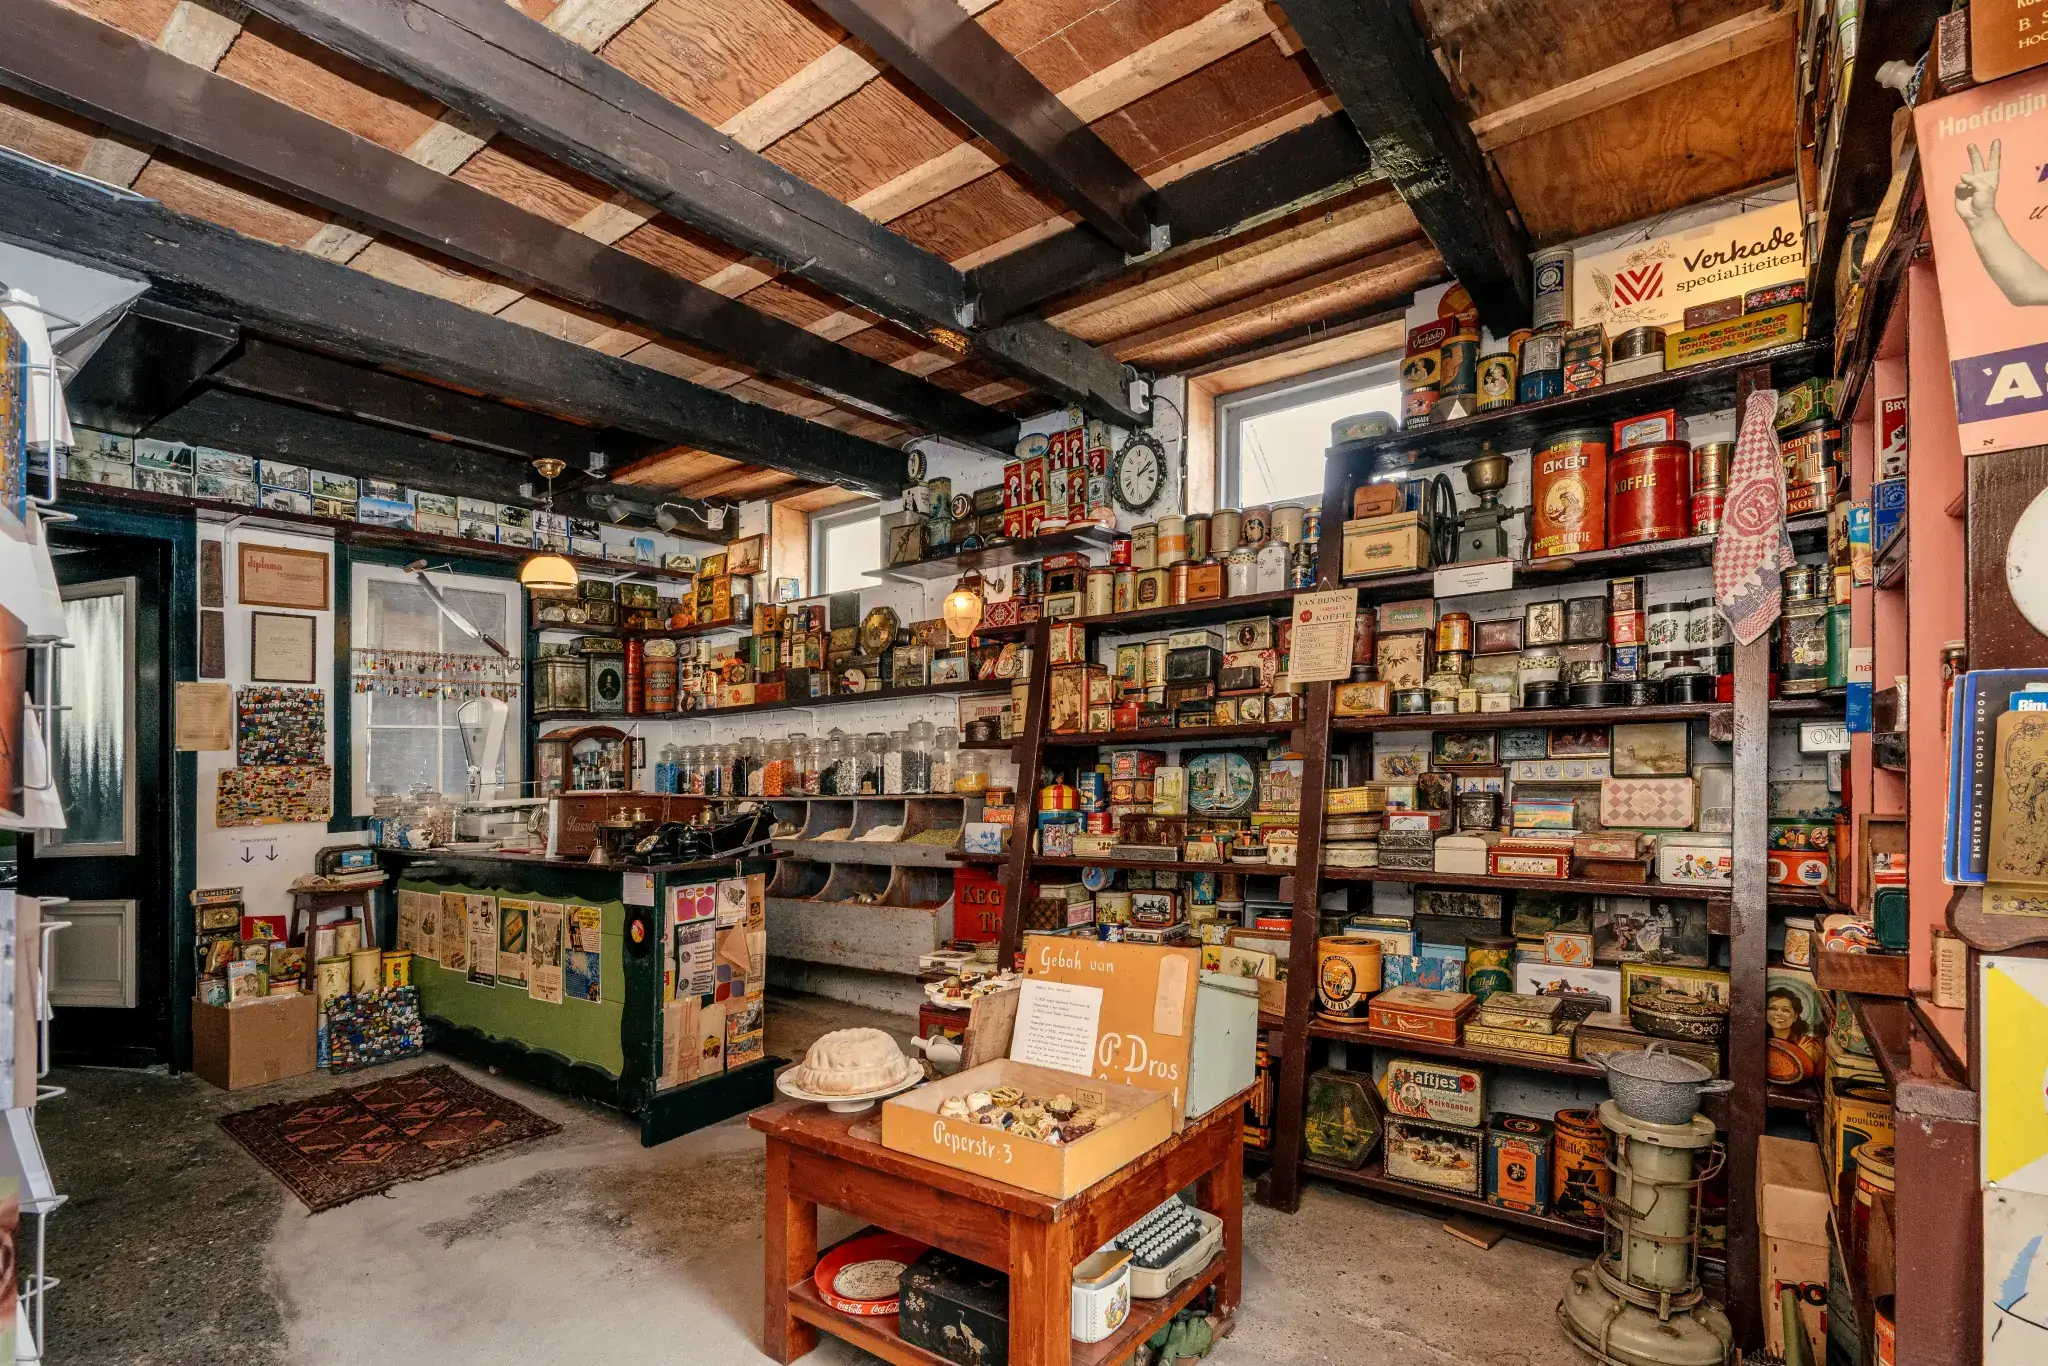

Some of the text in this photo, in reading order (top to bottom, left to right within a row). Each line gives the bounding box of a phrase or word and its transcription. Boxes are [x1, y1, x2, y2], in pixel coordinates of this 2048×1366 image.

[1938, 92, 2047, 138] Hoofdpijn
[1683, 226, 1797, 273] Verkade
[1676, 251, 1803, 292] specialiteiten
[1614, 473, 1657, 495] KOFFIE
[247, 556, 282, 573] diploma
[1299, 598, 1316, 607] VAN
[1316, 612, 1352, 622] KOFFIE
[1972, 691, 1986, 859] VOOR SCHOOL EN TOERISME
[1090, 959, 1114, 974] van
[1124, 1034, 1178, 1080] Dros
[1428, 1098, 1474, 1113] Melkbonbon
[1846, 1115, 1885, 1128] BOUILLON
[1866, 1110, 1894, 1122] HONIG
[1003, 1143, 1013, 1164] 3
